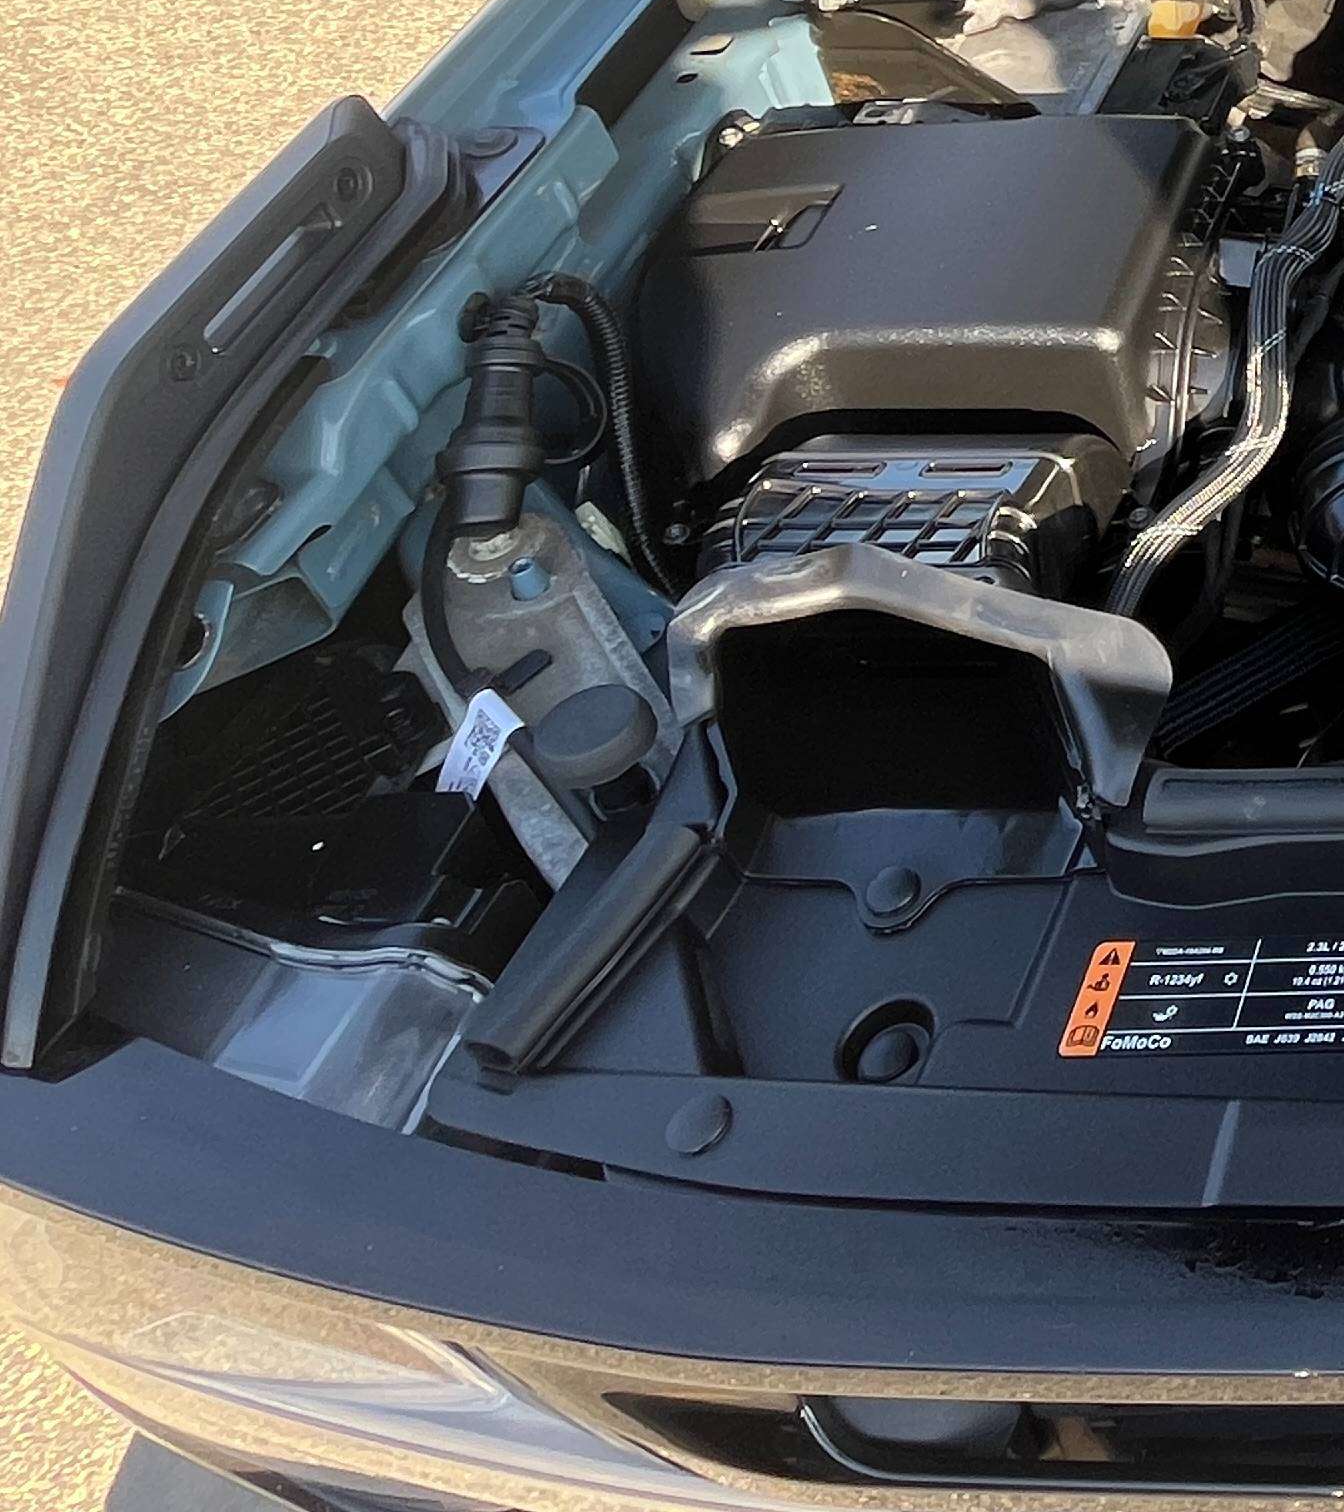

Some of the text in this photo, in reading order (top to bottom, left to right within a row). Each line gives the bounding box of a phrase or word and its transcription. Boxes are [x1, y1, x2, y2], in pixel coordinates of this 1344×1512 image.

[1149, 973, 1205, 987] R-1234yf
[1306, 998, 1335, 1010] PAG
[1100, 1034, 1172, 1050] FoMoCo
